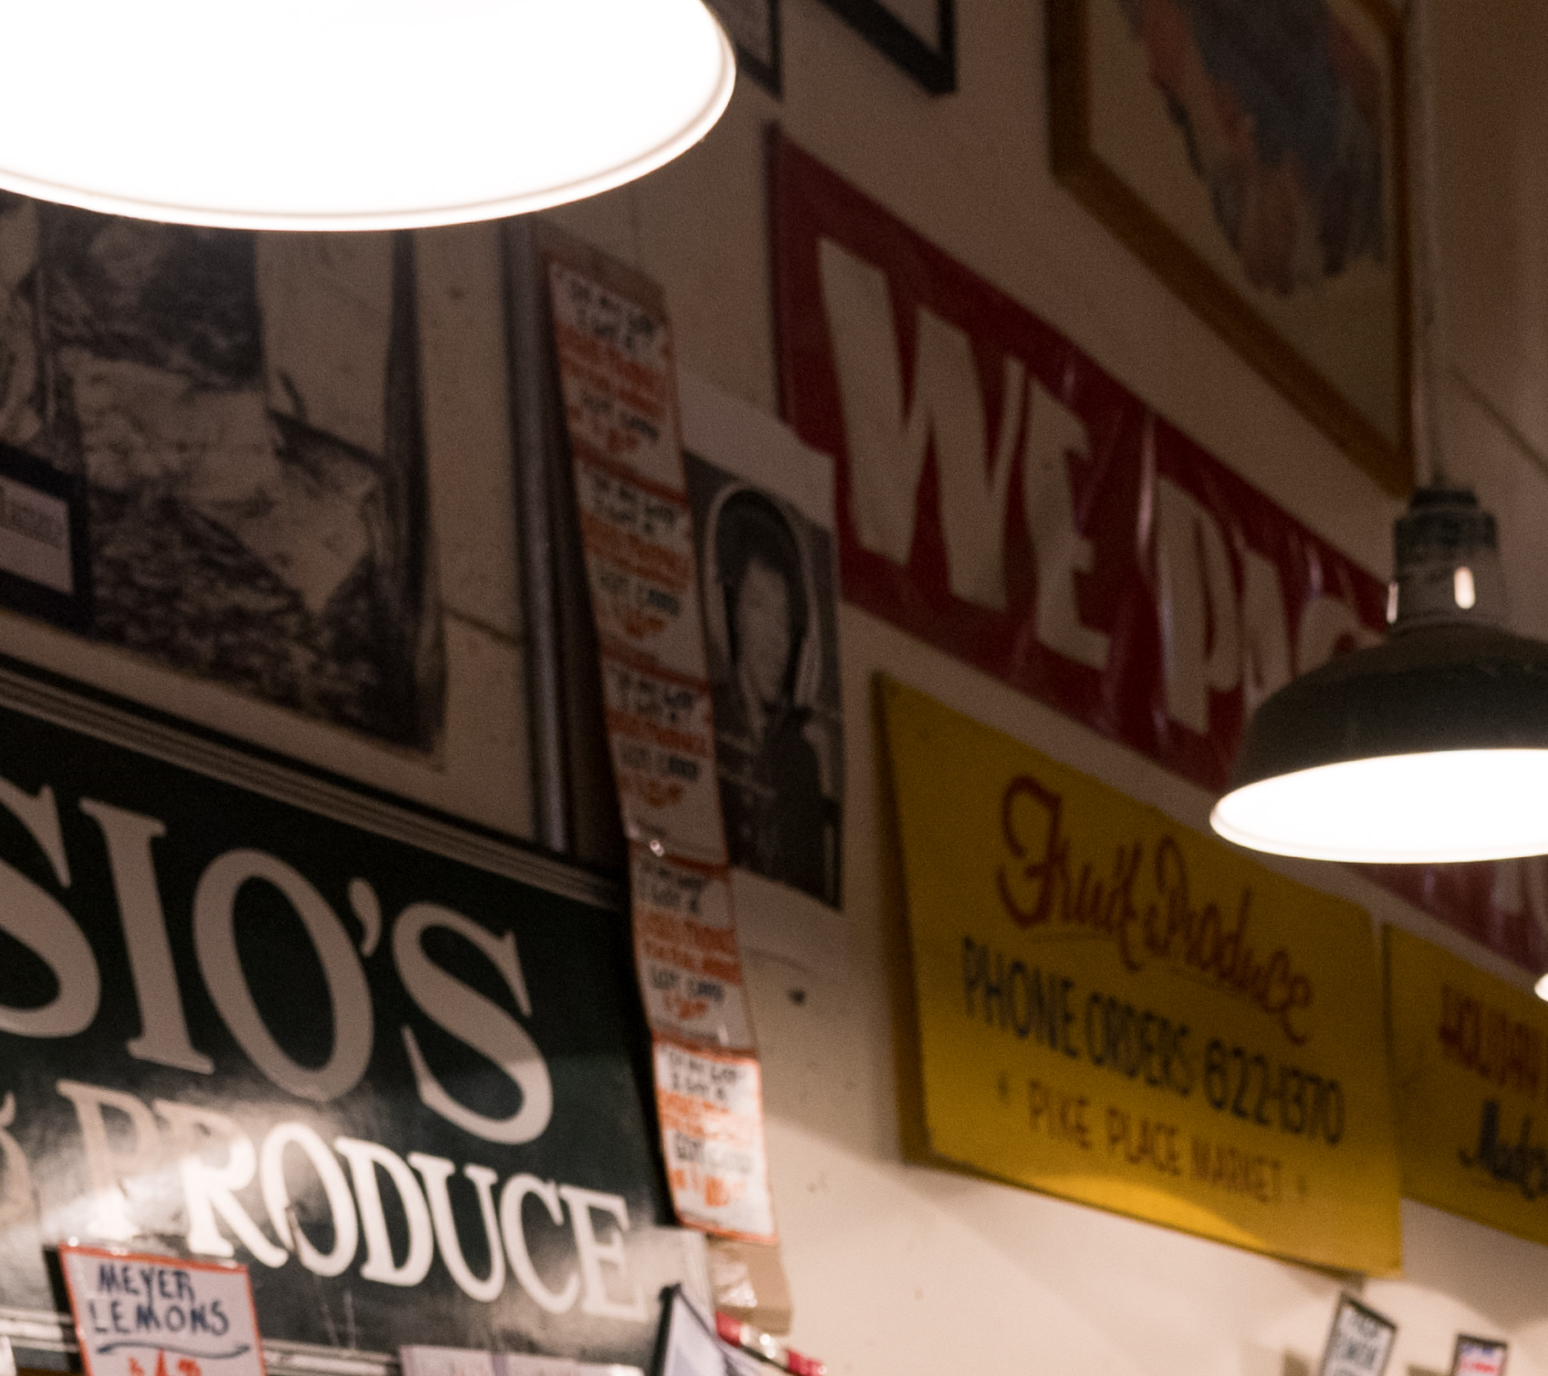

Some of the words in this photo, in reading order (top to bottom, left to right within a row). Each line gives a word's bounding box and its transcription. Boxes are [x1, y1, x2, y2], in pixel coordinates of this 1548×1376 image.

[818, 235, 1113, 672] WE
[962, 934, 1077, 1060] PHONE
[1087, 991, 1194, 1098] ORDERS
[58, 1079, 650, 1321] PRODUCE
[1027, 1078, 1092, 1151] PIKE
[1107, 1105, 1181, 1178] PLACE
[1191, 1137, 1285, 1206] MARKET
[91, 1299, 231, 1338] LEMONS
[98, 1263, 196, 1304] MEYER
